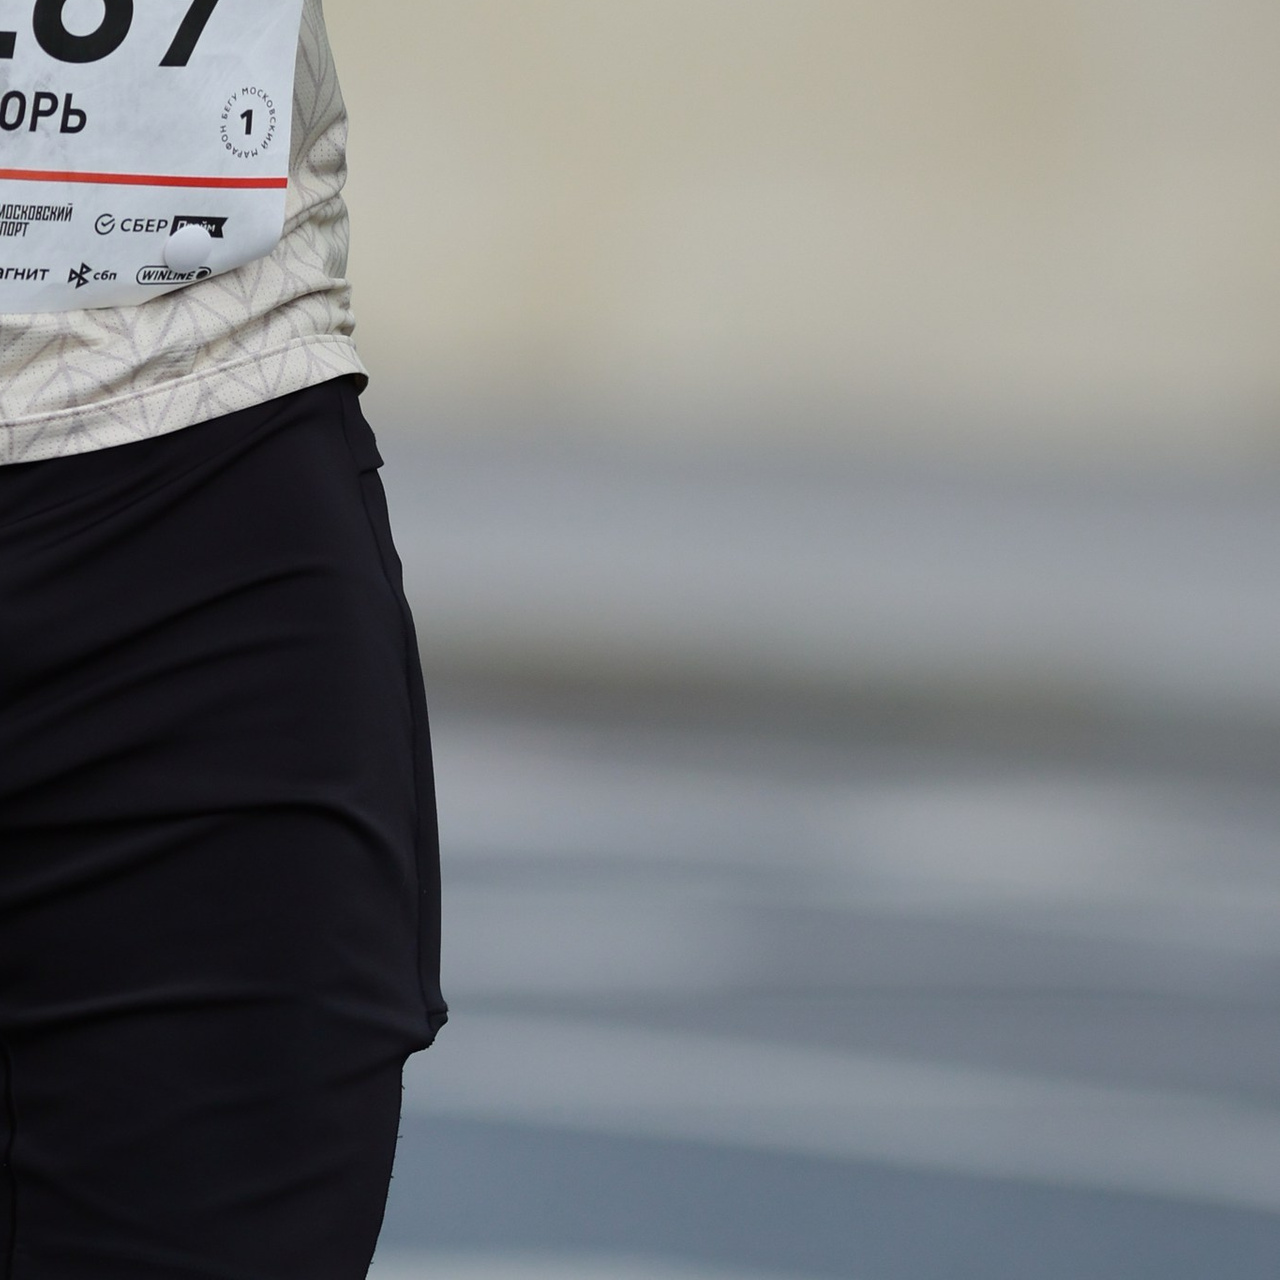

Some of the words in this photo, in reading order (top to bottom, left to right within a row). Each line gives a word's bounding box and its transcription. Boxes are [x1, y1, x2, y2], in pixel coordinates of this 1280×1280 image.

[240, 109, 253, 136] 1
[120, 218, 168, 233] СБЕР
[142, 270, 196, 281] WINLINE
